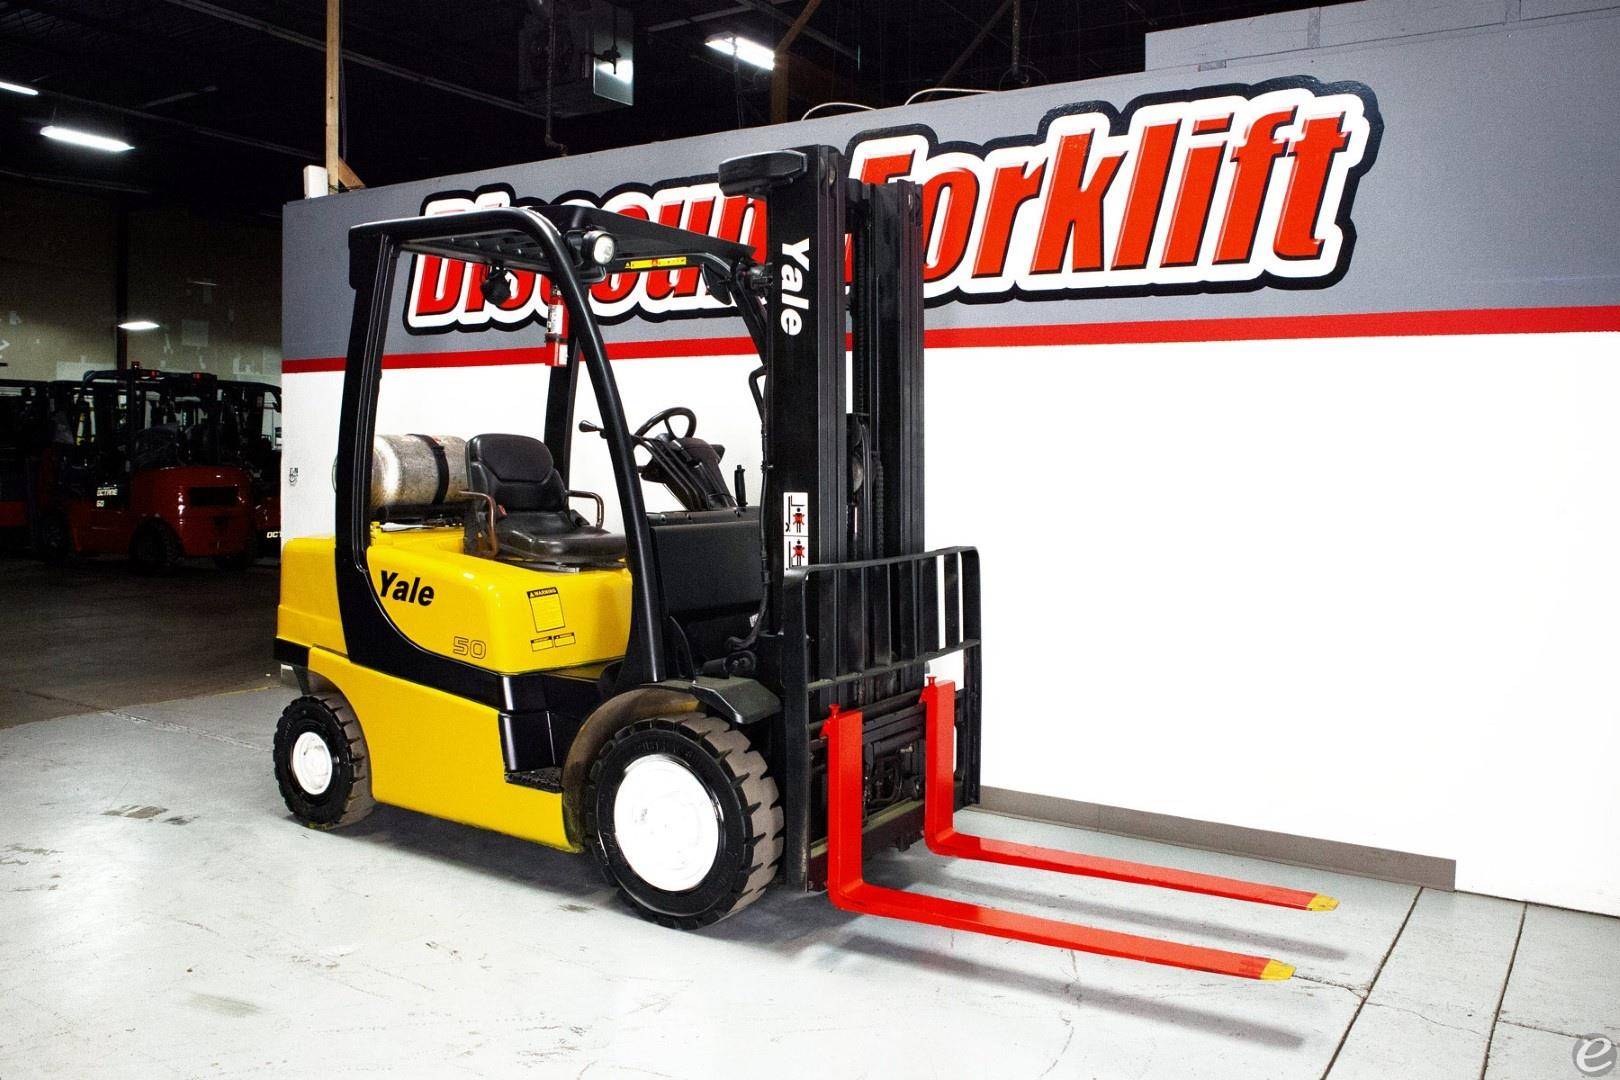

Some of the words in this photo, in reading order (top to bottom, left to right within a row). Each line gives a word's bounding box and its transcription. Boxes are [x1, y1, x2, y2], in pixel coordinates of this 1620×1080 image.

[780, 237, 810, 336] Yale
[379, 569, 435, 607] Yale
[533, 588, 557, 597] WARNING
[453, 636, 487, 660] 50
